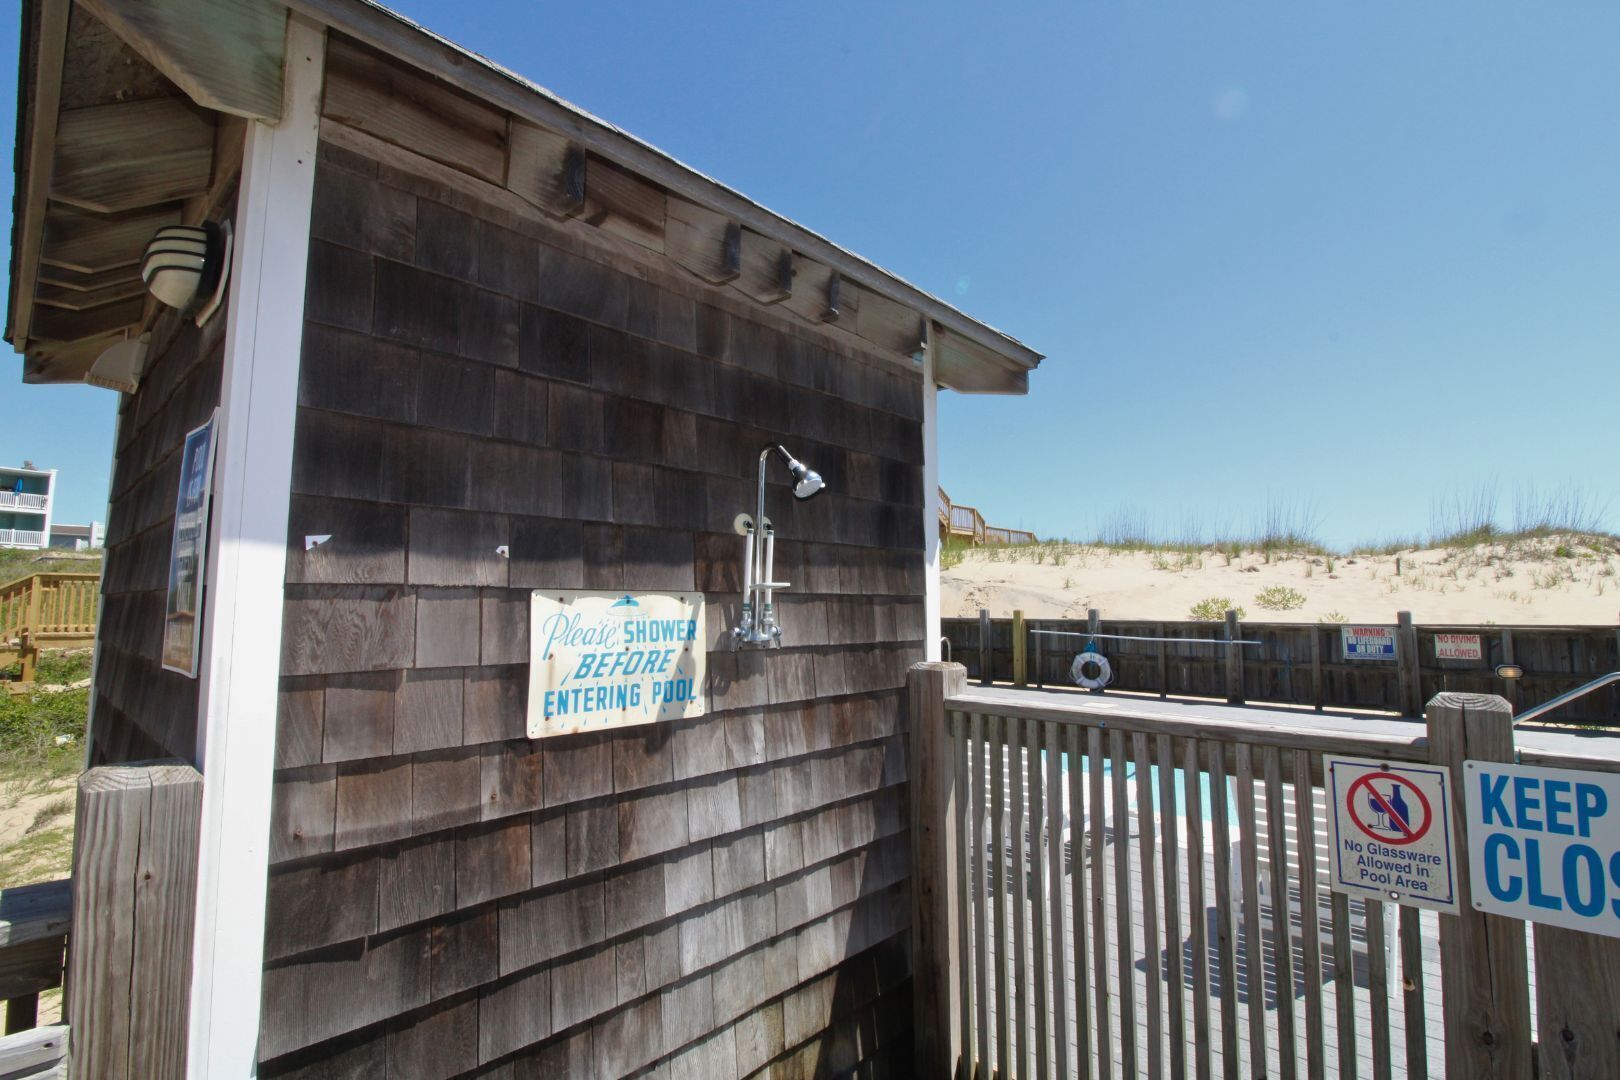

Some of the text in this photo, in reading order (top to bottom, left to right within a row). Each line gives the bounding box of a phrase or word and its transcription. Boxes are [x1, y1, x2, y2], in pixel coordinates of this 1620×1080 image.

[543, 607, 697, 660] Please SHOWER
[1352, 628, 1385, 637] WARNING
[1437, 634, 1478, 644] NO DIVING
[1367, 645, 1384, 654] DUTY
[1438, 649, 1478, 658] ALLOWED
[573, 649, 676, 680] BEFORE
[544, 678, 697, 717] ENTERING POOL
[1479, 773, 1608, 838] KEEP
[1344, 839, 1441, 865] No Glassware
[1357, 854, 1430, 878] Allowed in
[1484, 832, 1620, 919] CLO
[1360, 869, 1428, 891] Pool Area
